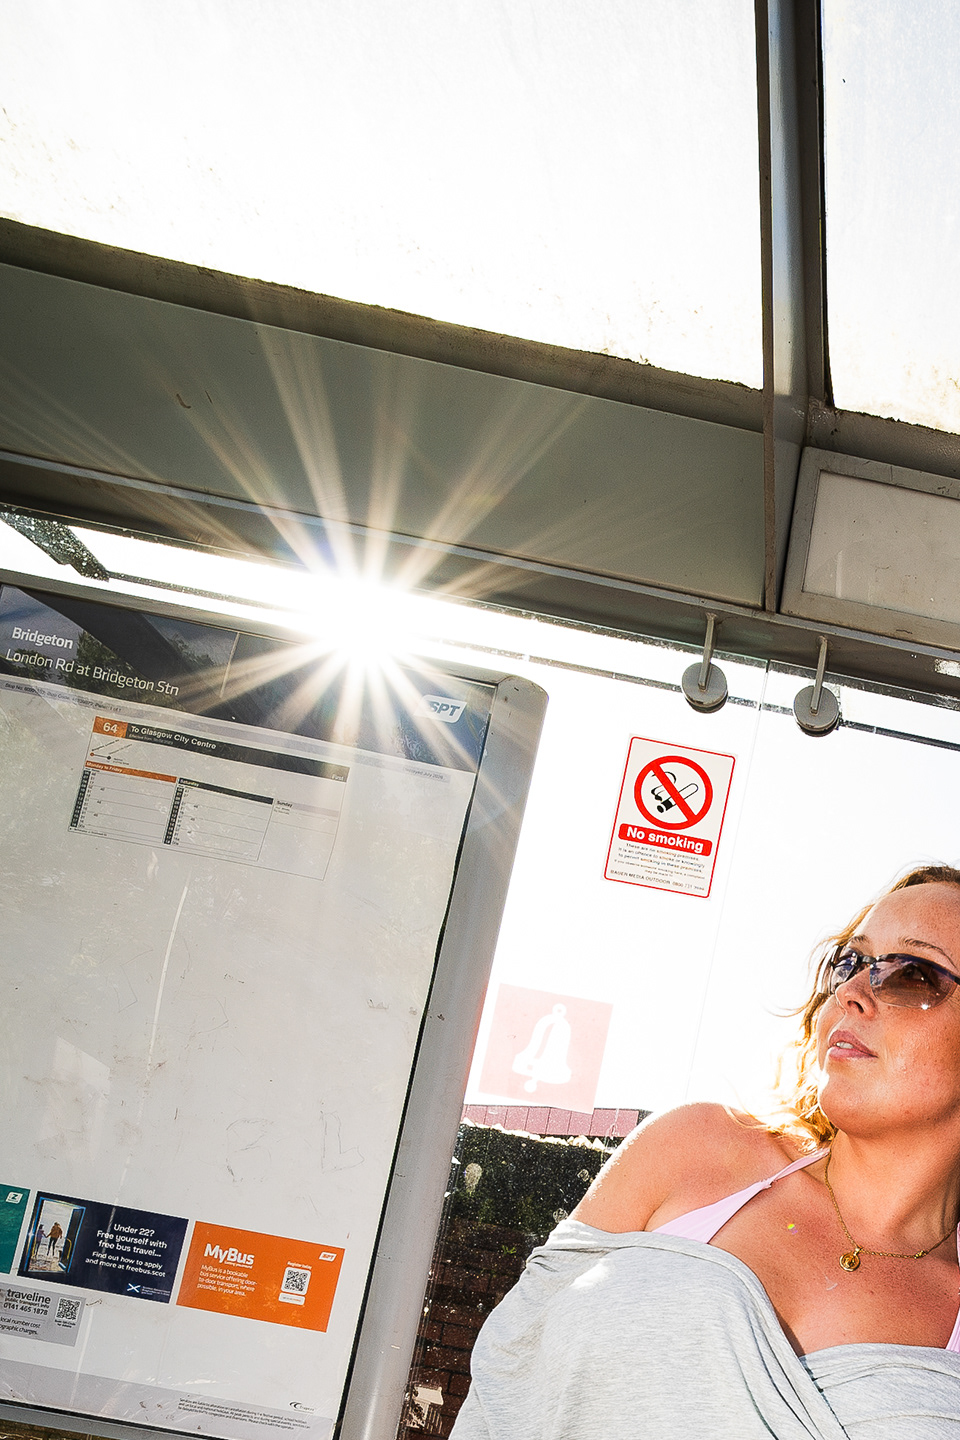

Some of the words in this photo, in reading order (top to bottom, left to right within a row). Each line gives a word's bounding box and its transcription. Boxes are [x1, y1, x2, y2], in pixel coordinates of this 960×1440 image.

[12, 627, 73, 649] Bridgeton
[6, 649, 52, 668] London
[55, 657, 74, 672] Rd
[76, 664, 90, 677] at
[93, 666, 154, 690] Bridgeton
[156, 680, 179, 696] Stn
[430, 701, 461, 717] SPT
[103, 722, 118, 733] 64
[141, 727, 172, 740] Glasgow
[174, 734, 190, 744] City
[191, 738, 217, 750] Centre
[626, 826, 645, 840] No
[648, 833, 703, 854] smoking
[113, 1224, 138, 1234] Under
[138, 1228, 155, 1237] 22?
[97, 1230, 114, 1239] Free
[115, 1235, 148, 1245] yourself
[149, 1240, 167, 1249] with
[98, 1240, 115, 1249] free
[116, 1243, 131, 1252] bus
[92, 1251, 107, 1259] Find
[120, 1256, 135, 1264] how
[144, 1261, 163, 1270] apply
[204, 1243, 255, 1265] MyBus
[125, 1265, 166, 1277] freebus.scot
[201, 1265, 218, 1273] MyBus
[227, 1269, 249, 1278] bookable
[226, 1275, 244, 1284] offering
[7, 1289, 51, 1304] traveline
[3, 1302, 19, 1310] 0141
